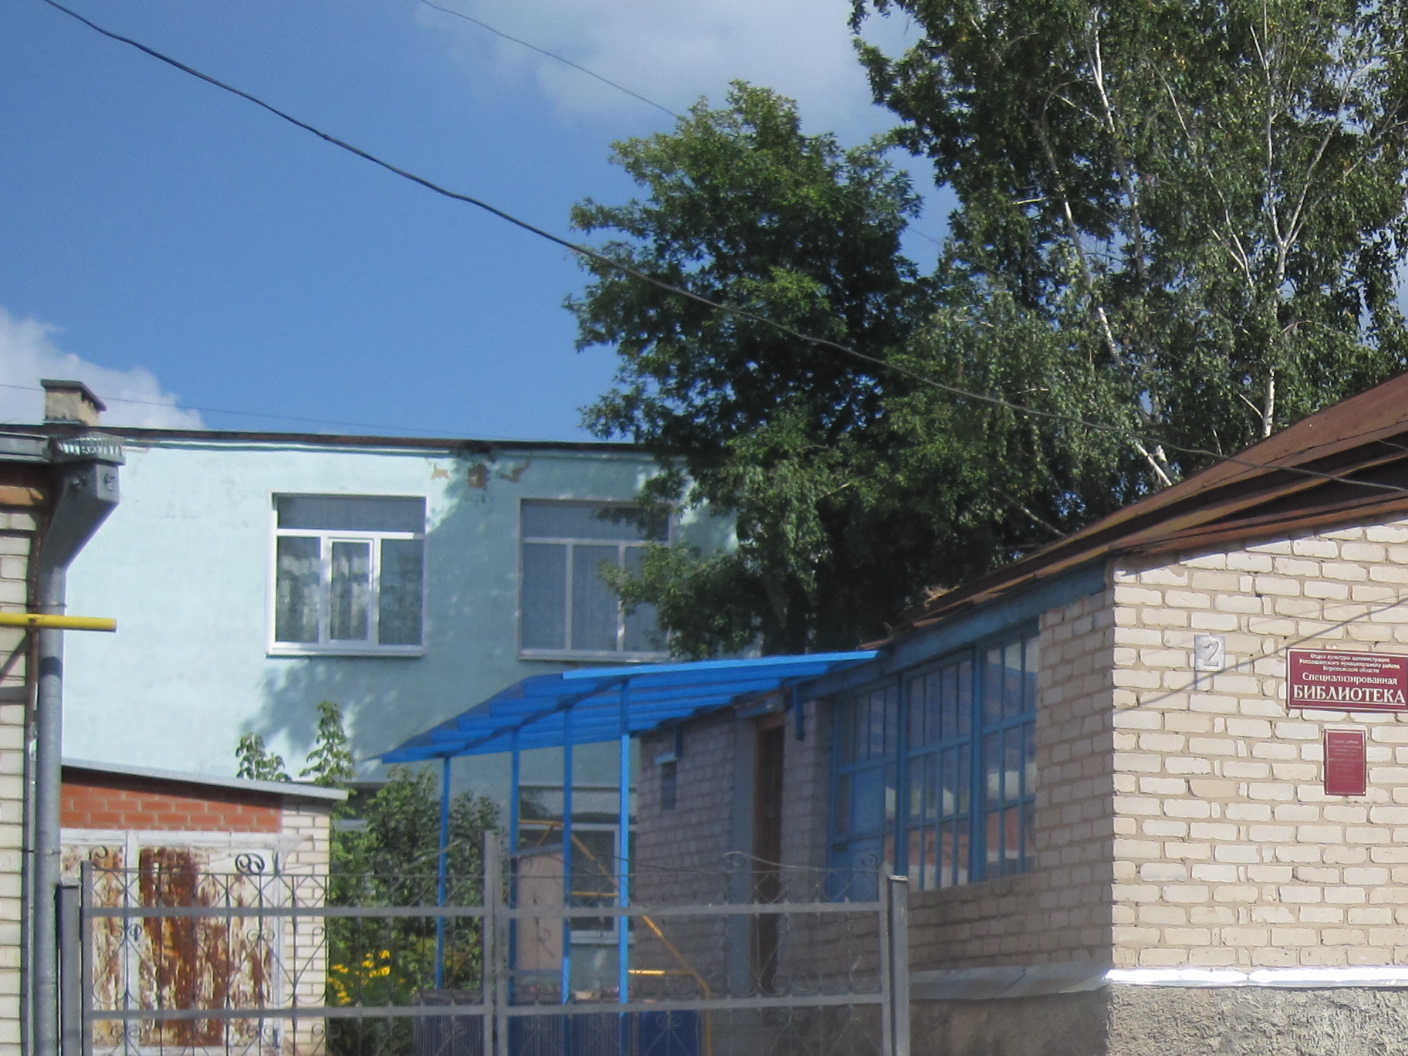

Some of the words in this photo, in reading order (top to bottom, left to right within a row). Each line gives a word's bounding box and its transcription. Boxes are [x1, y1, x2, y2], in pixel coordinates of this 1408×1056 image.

[1204, 637, 1219, 667] 2
[1302, 672, 1398, 686] Специализированная
[1293, 685, 1406, 704] БИБЛИОТЕКА
